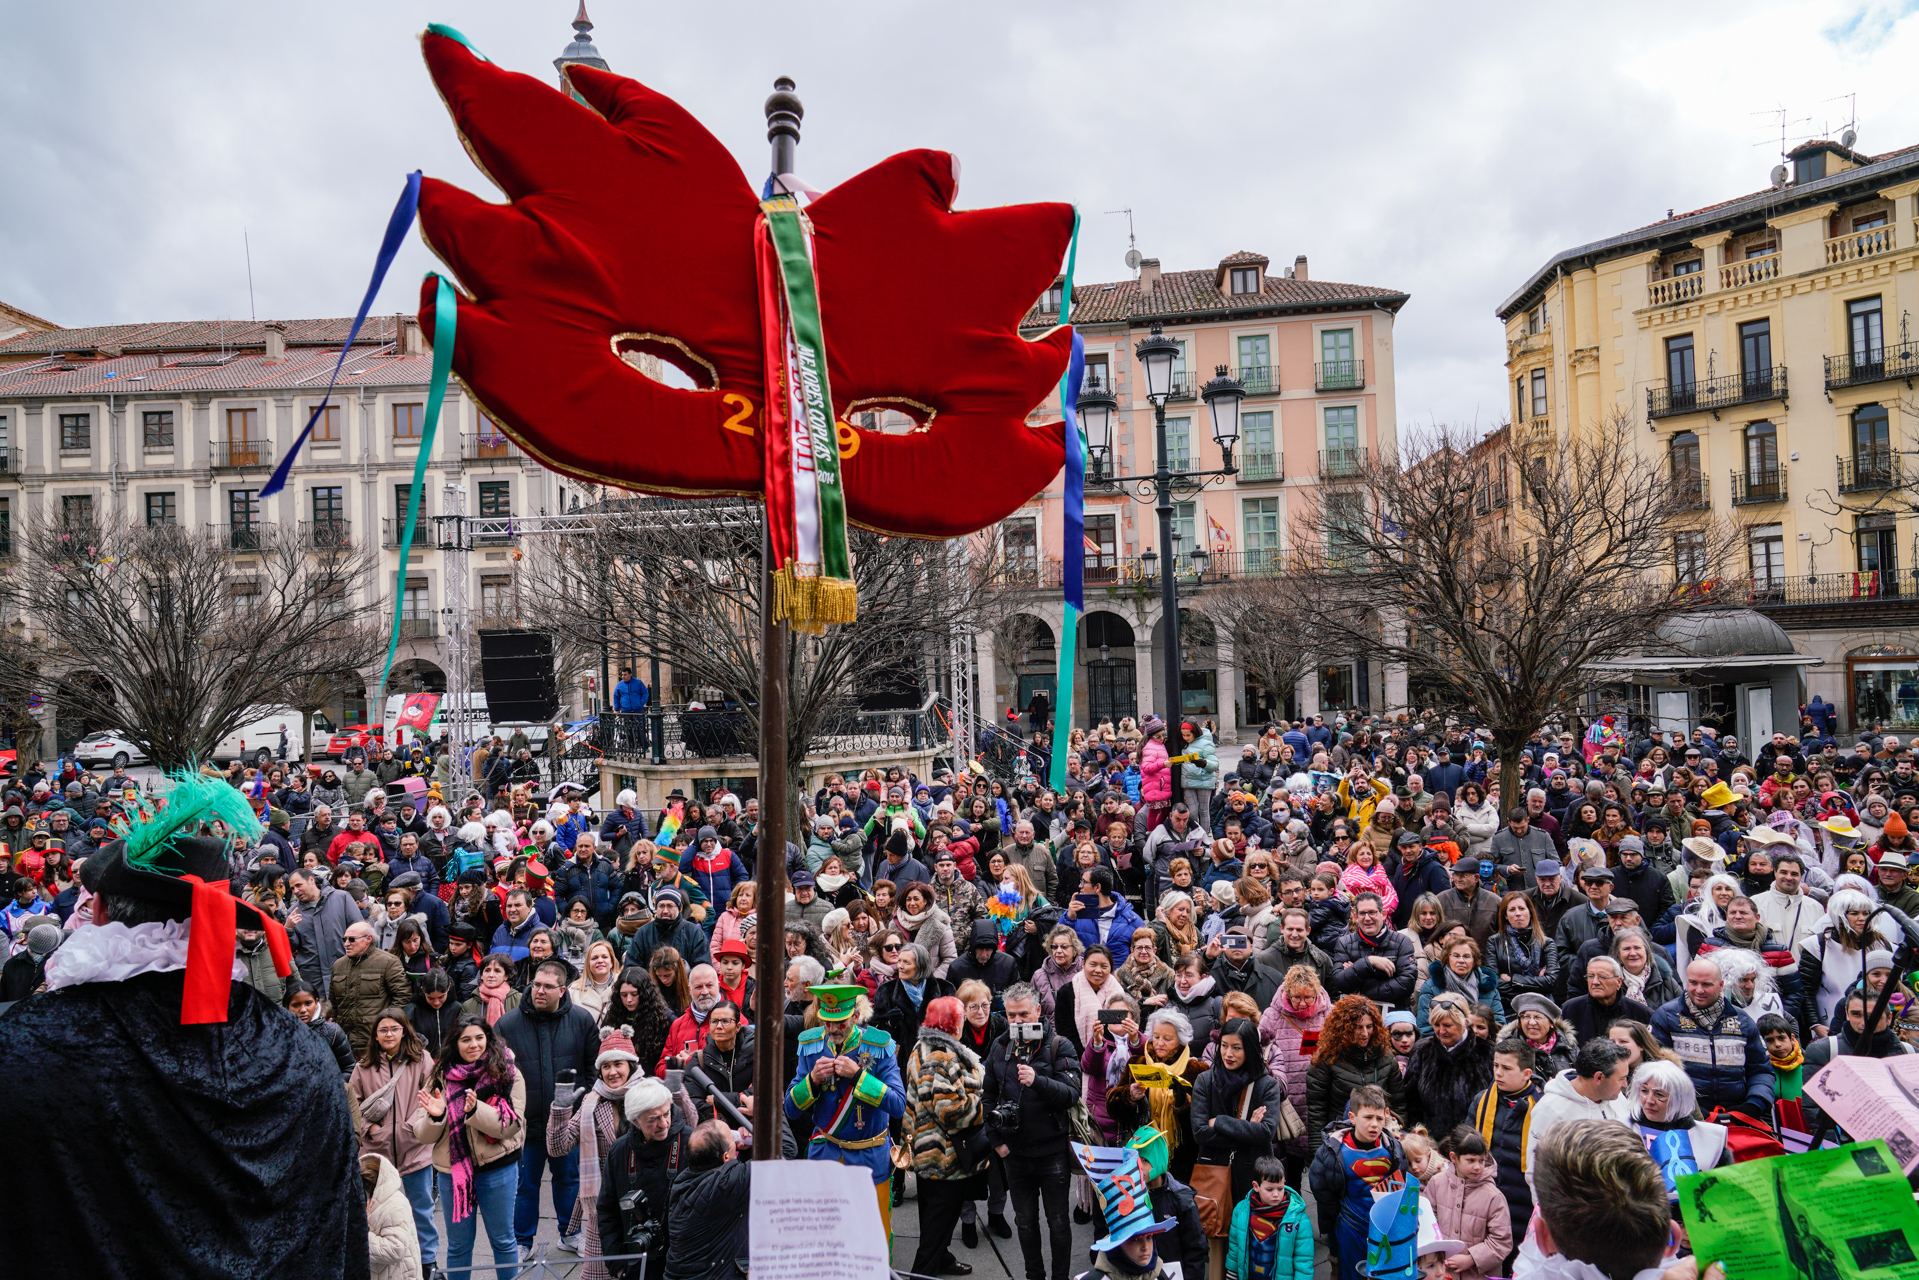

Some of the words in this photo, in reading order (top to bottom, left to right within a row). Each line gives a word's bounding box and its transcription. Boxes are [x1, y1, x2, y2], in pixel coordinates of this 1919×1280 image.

[797, 343, 824, 409] MEJORES
[808, 408, 832, 462] COPLAS
[817, 470, 835, 485] 2014
